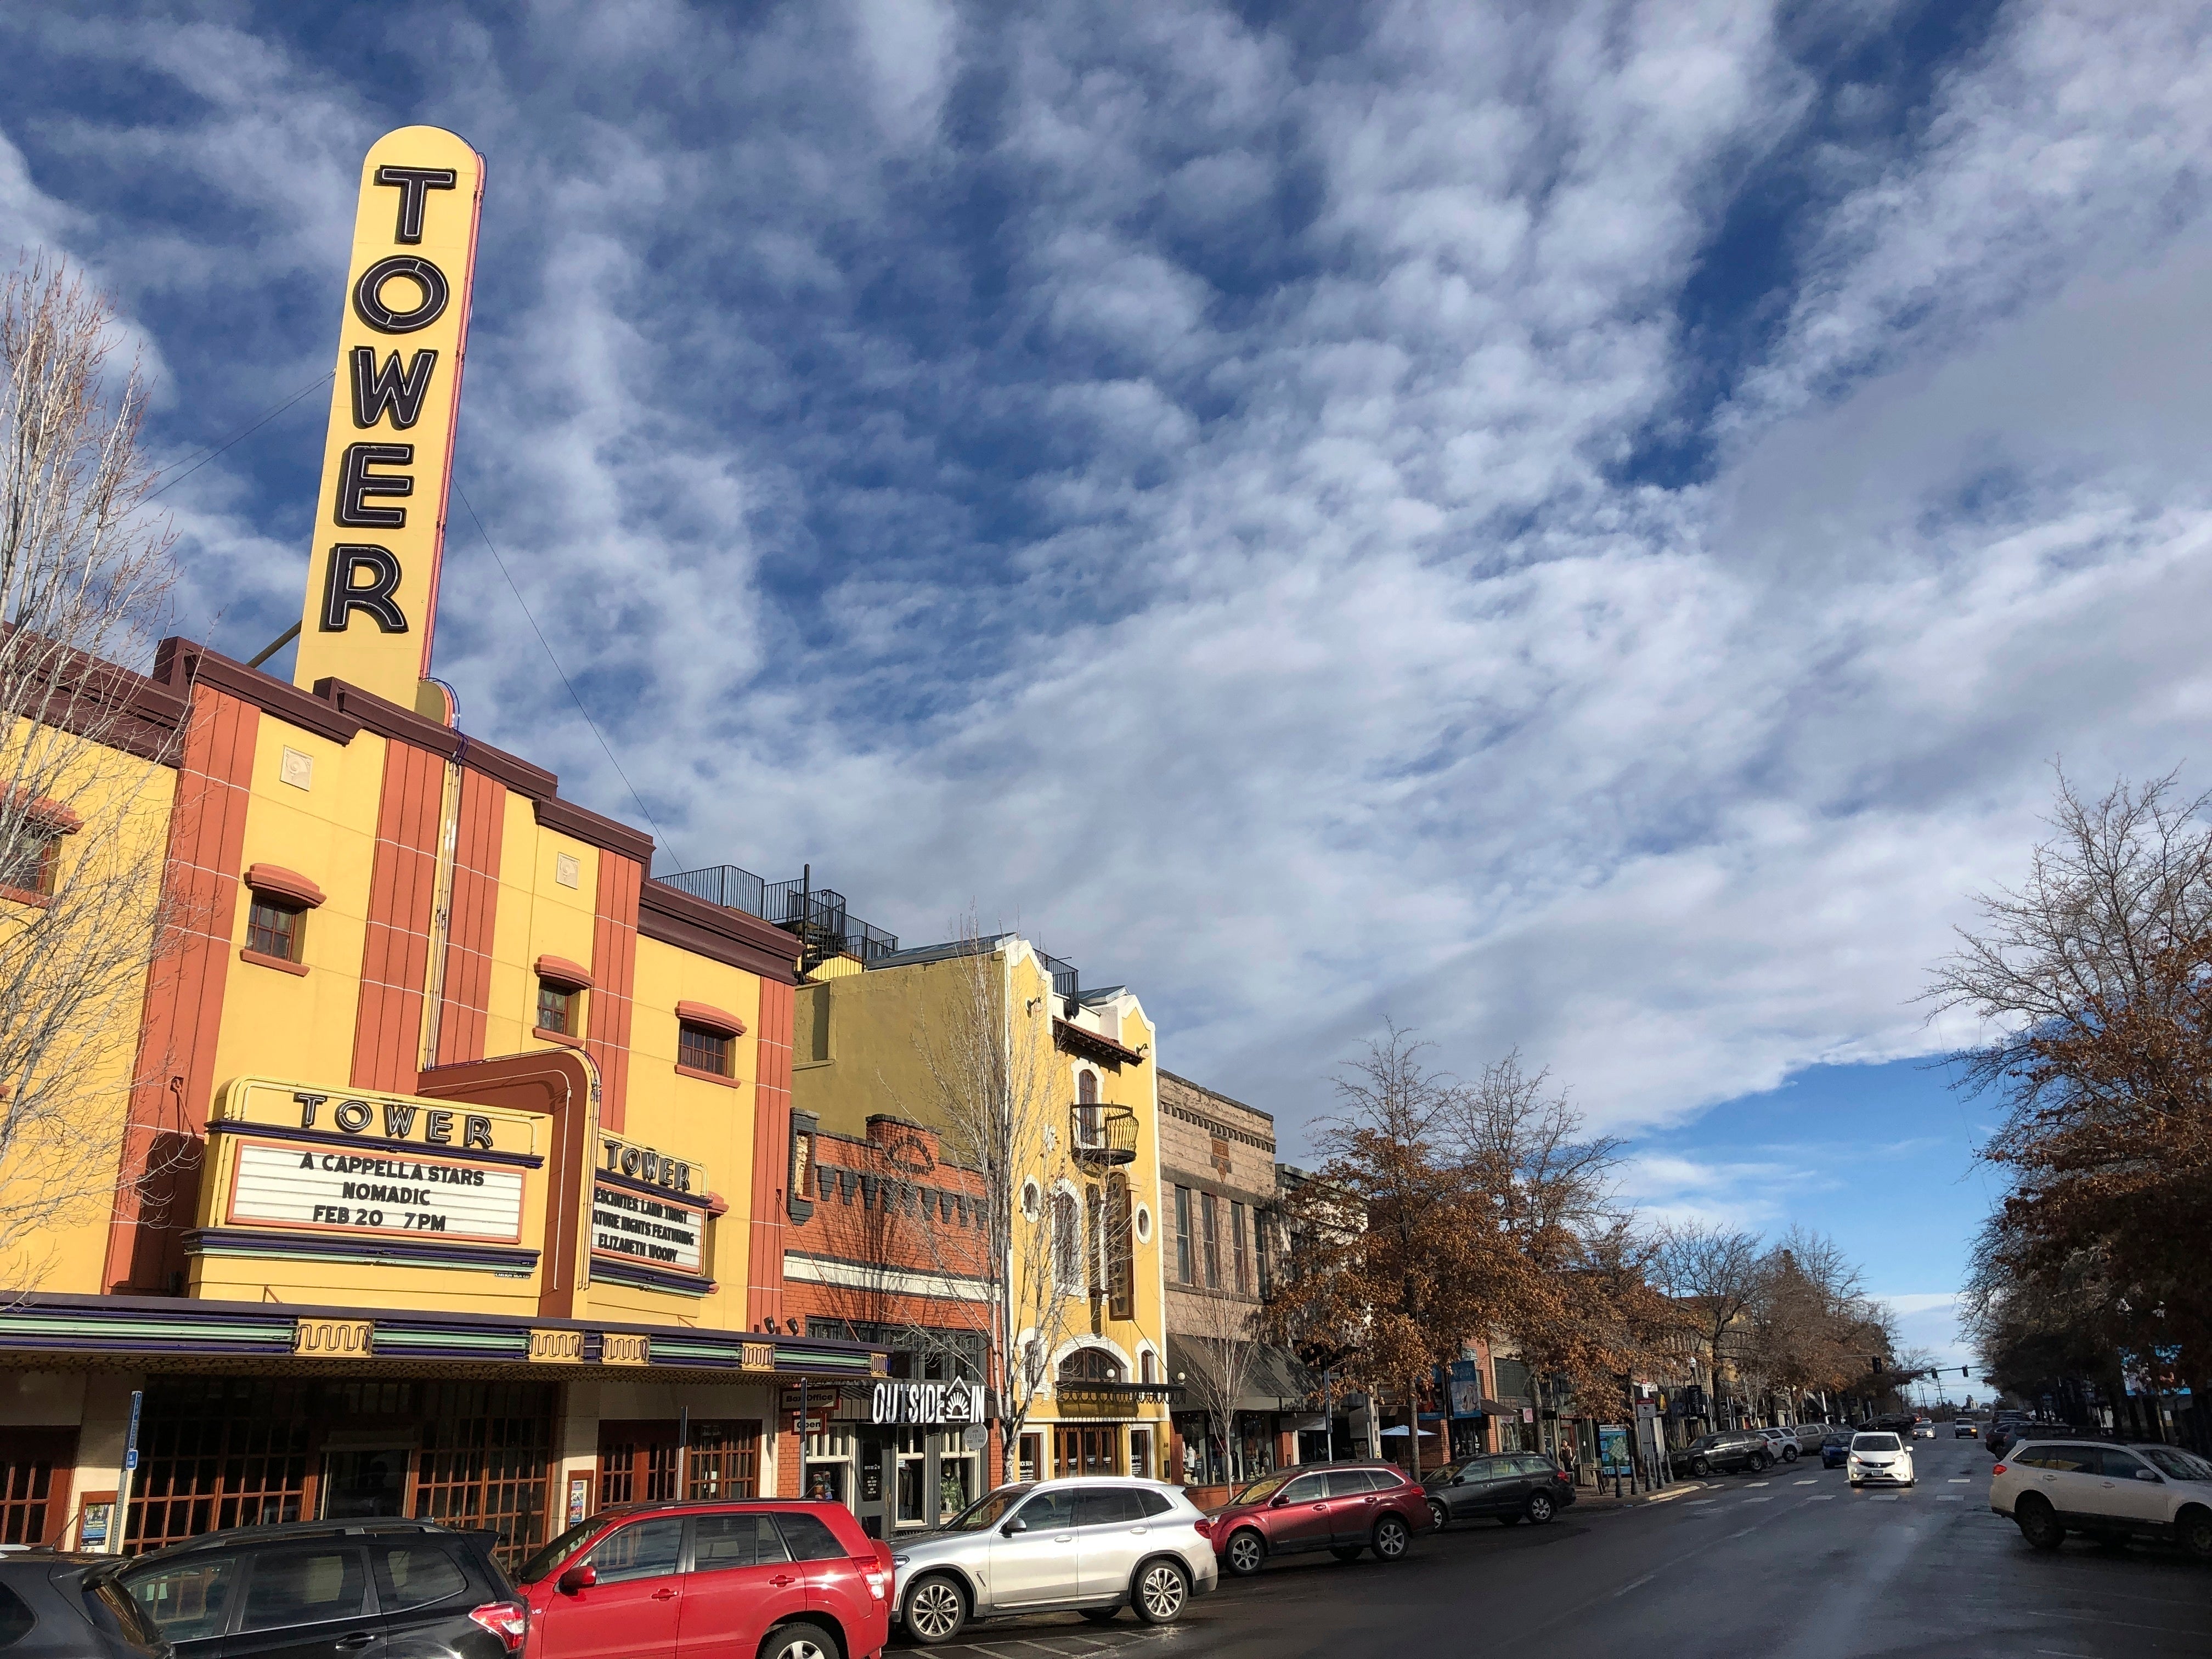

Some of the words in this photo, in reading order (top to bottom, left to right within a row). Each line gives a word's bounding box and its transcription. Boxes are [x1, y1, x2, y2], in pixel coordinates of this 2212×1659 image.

[320, 165, 456, 633] TOWER
[294, 1092, 493, 1149] TOWER
[300, 1152, 314, 1170] A
[322, 1154, 424, 1181] CAPPELLA
[428, 1166, 484, 1186] STARS
[604, 1139, 690, 1192] TOWER
[342, 1181, 431, 1205] NOMADIC
[594, 1187, 638, 1212] ESCHUTES
[641, 1199, 662, 1218] LAND
[664, 1205, 688, 1224] TRUST
[313, 1204, 349, 1224] FEB
[355, 1209, 383, 1226] 20
[403, 1212, 446, 1232] 7PM
[593, 1209, 619, 1229] ATURE
[622, 1216, 651, 1236] NIGHTS
[652, 1223, 694, 1246] FEATURING
[598, 1233, 646, 1256] ELIZABETH
[649, 1243, 678, 1262] WOODY
[872, 1383, 946, 1424] OUTSIDE
[970, 1385, 985, 1423] IN
